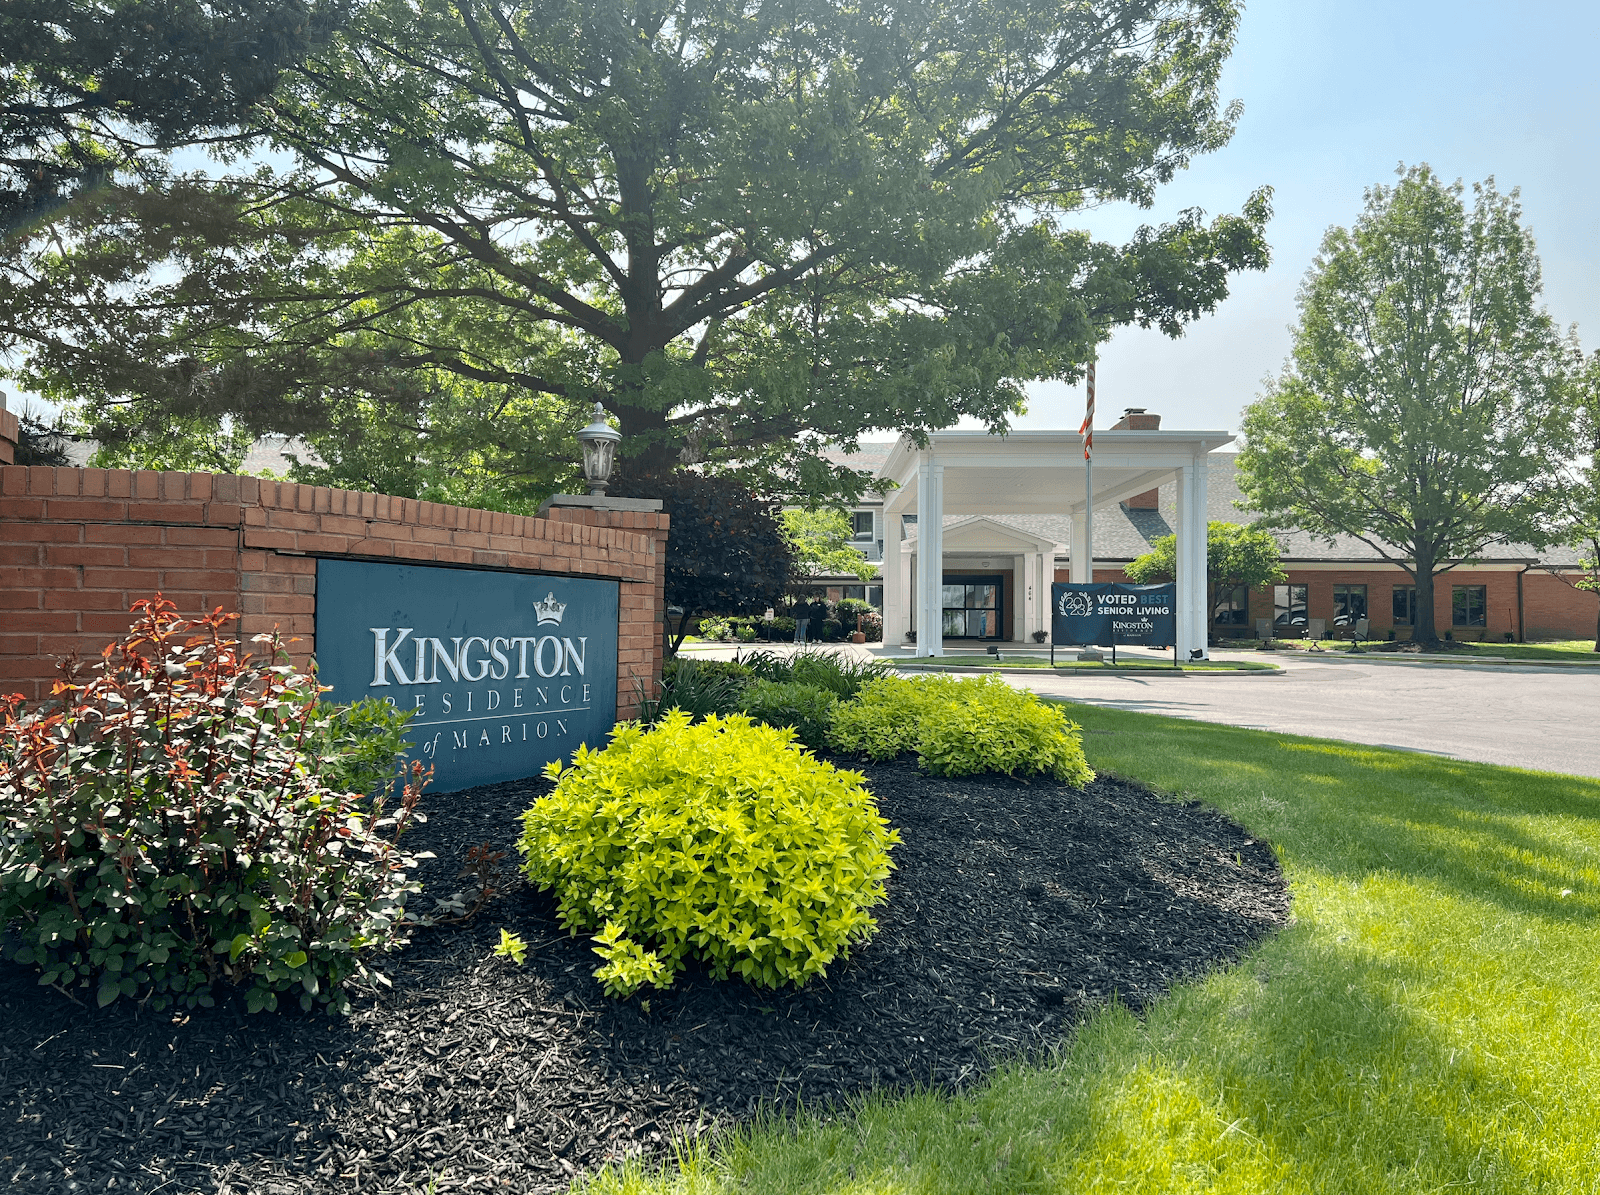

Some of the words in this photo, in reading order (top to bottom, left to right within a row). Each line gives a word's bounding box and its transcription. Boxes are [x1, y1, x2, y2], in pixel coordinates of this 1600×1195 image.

[1097, 594, 1137, 605] VOTED
[1140, 594, 1169, 605] BEST
[1097, 606, 1134, 615] SENIOR
[1136, 606, 1170, 615] LIVING
[1112, 620, 1154, 629] KINGSTON
[369, 627, 588, 687] KINGSTON
[423, 732, 442, 759] of
[452, 718, 568, 750] MARION
